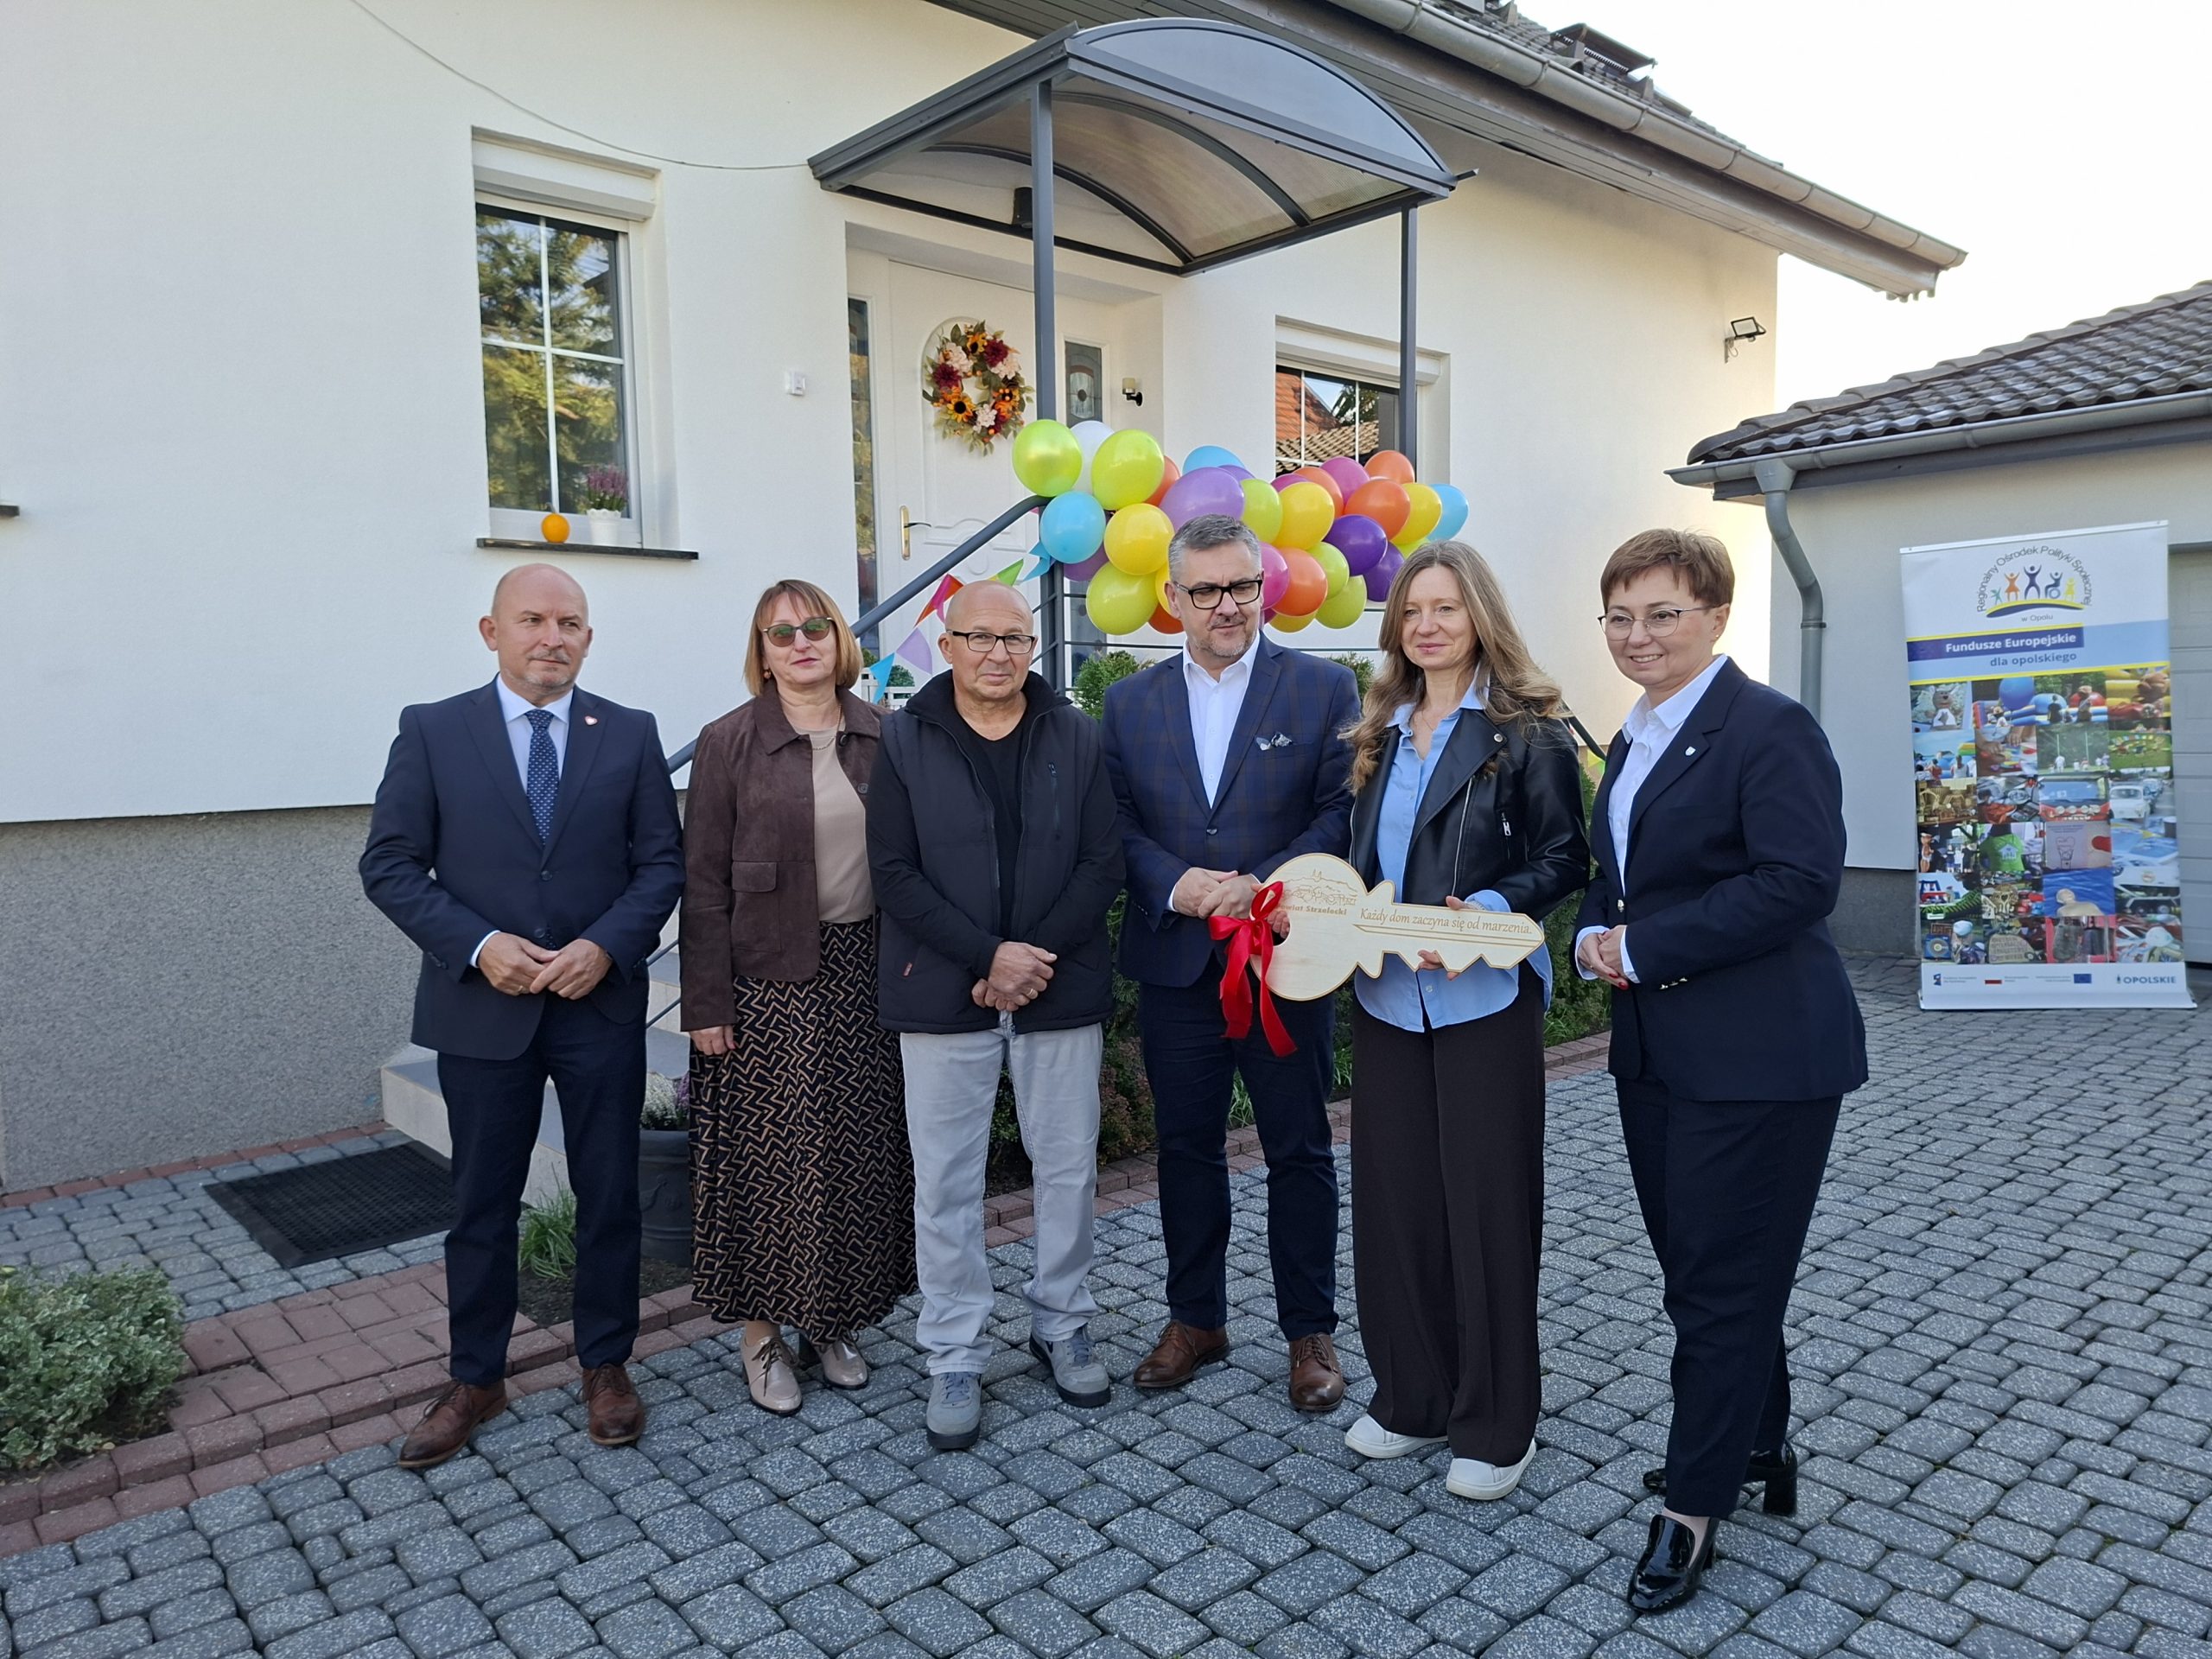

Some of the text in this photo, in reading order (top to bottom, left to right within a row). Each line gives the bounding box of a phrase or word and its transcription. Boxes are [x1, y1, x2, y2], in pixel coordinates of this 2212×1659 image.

[1977, 545, 2092, 612] Regionalny Ośrodek Polityki Społecznej
[2030, 613, 2053, 622] Opolu
[1946, 633, 2076, 652] Fundusze Europejskie
[1990, 652, 2077, 667] dla opolskiego
[1306, 905, 1347, 916] Strzelecki
[1360, 907, 1533, 935] Każdy dom zaczyna się od marzenia.
[2123, 976, 2177, 984] OPOLSKIE
